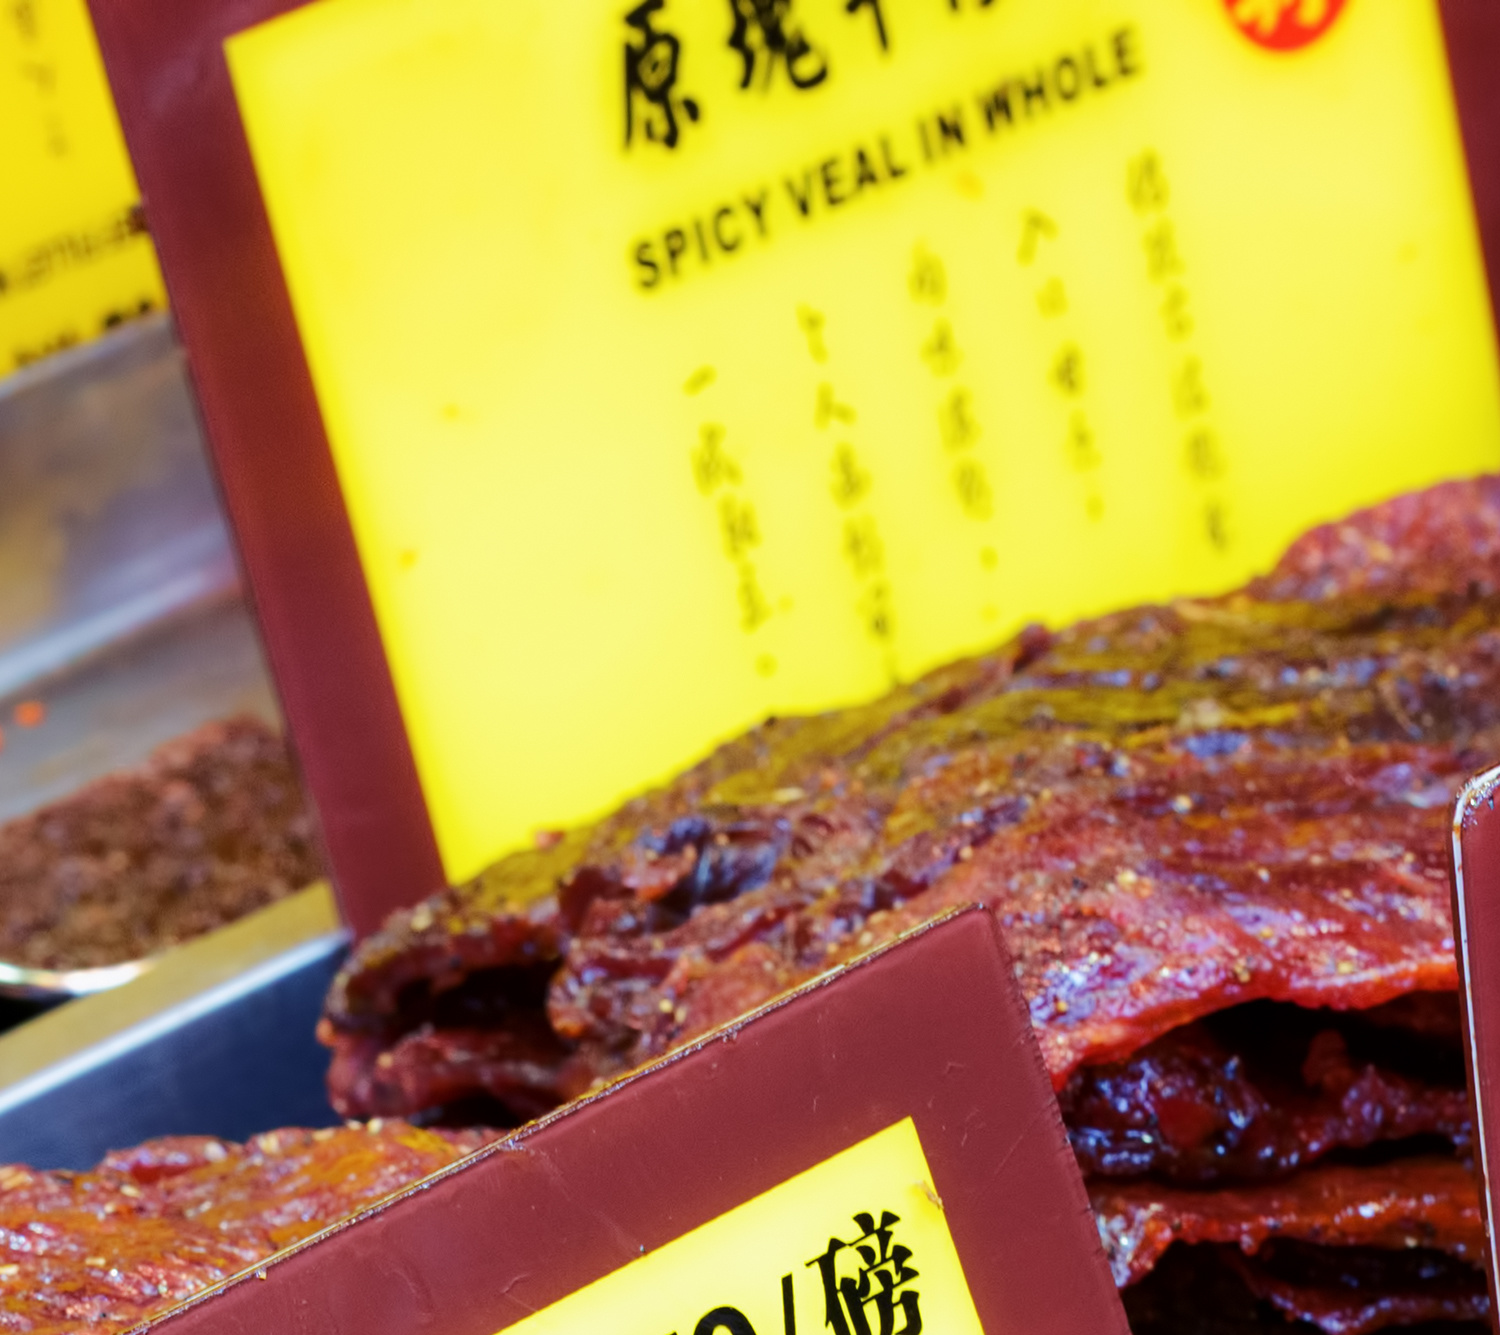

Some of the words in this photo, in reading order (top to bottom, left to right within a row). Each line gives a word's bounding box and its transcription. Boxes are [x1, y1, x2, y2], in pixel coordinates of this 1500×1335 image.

[621, 0, 996, 152] 原塊
[632, 188, 772, 292] SPICY
[785, 137, 909, 222] VEAL
[919, 100, 967, 163] IN
[978, 24, 1143, 138] WHOLE
